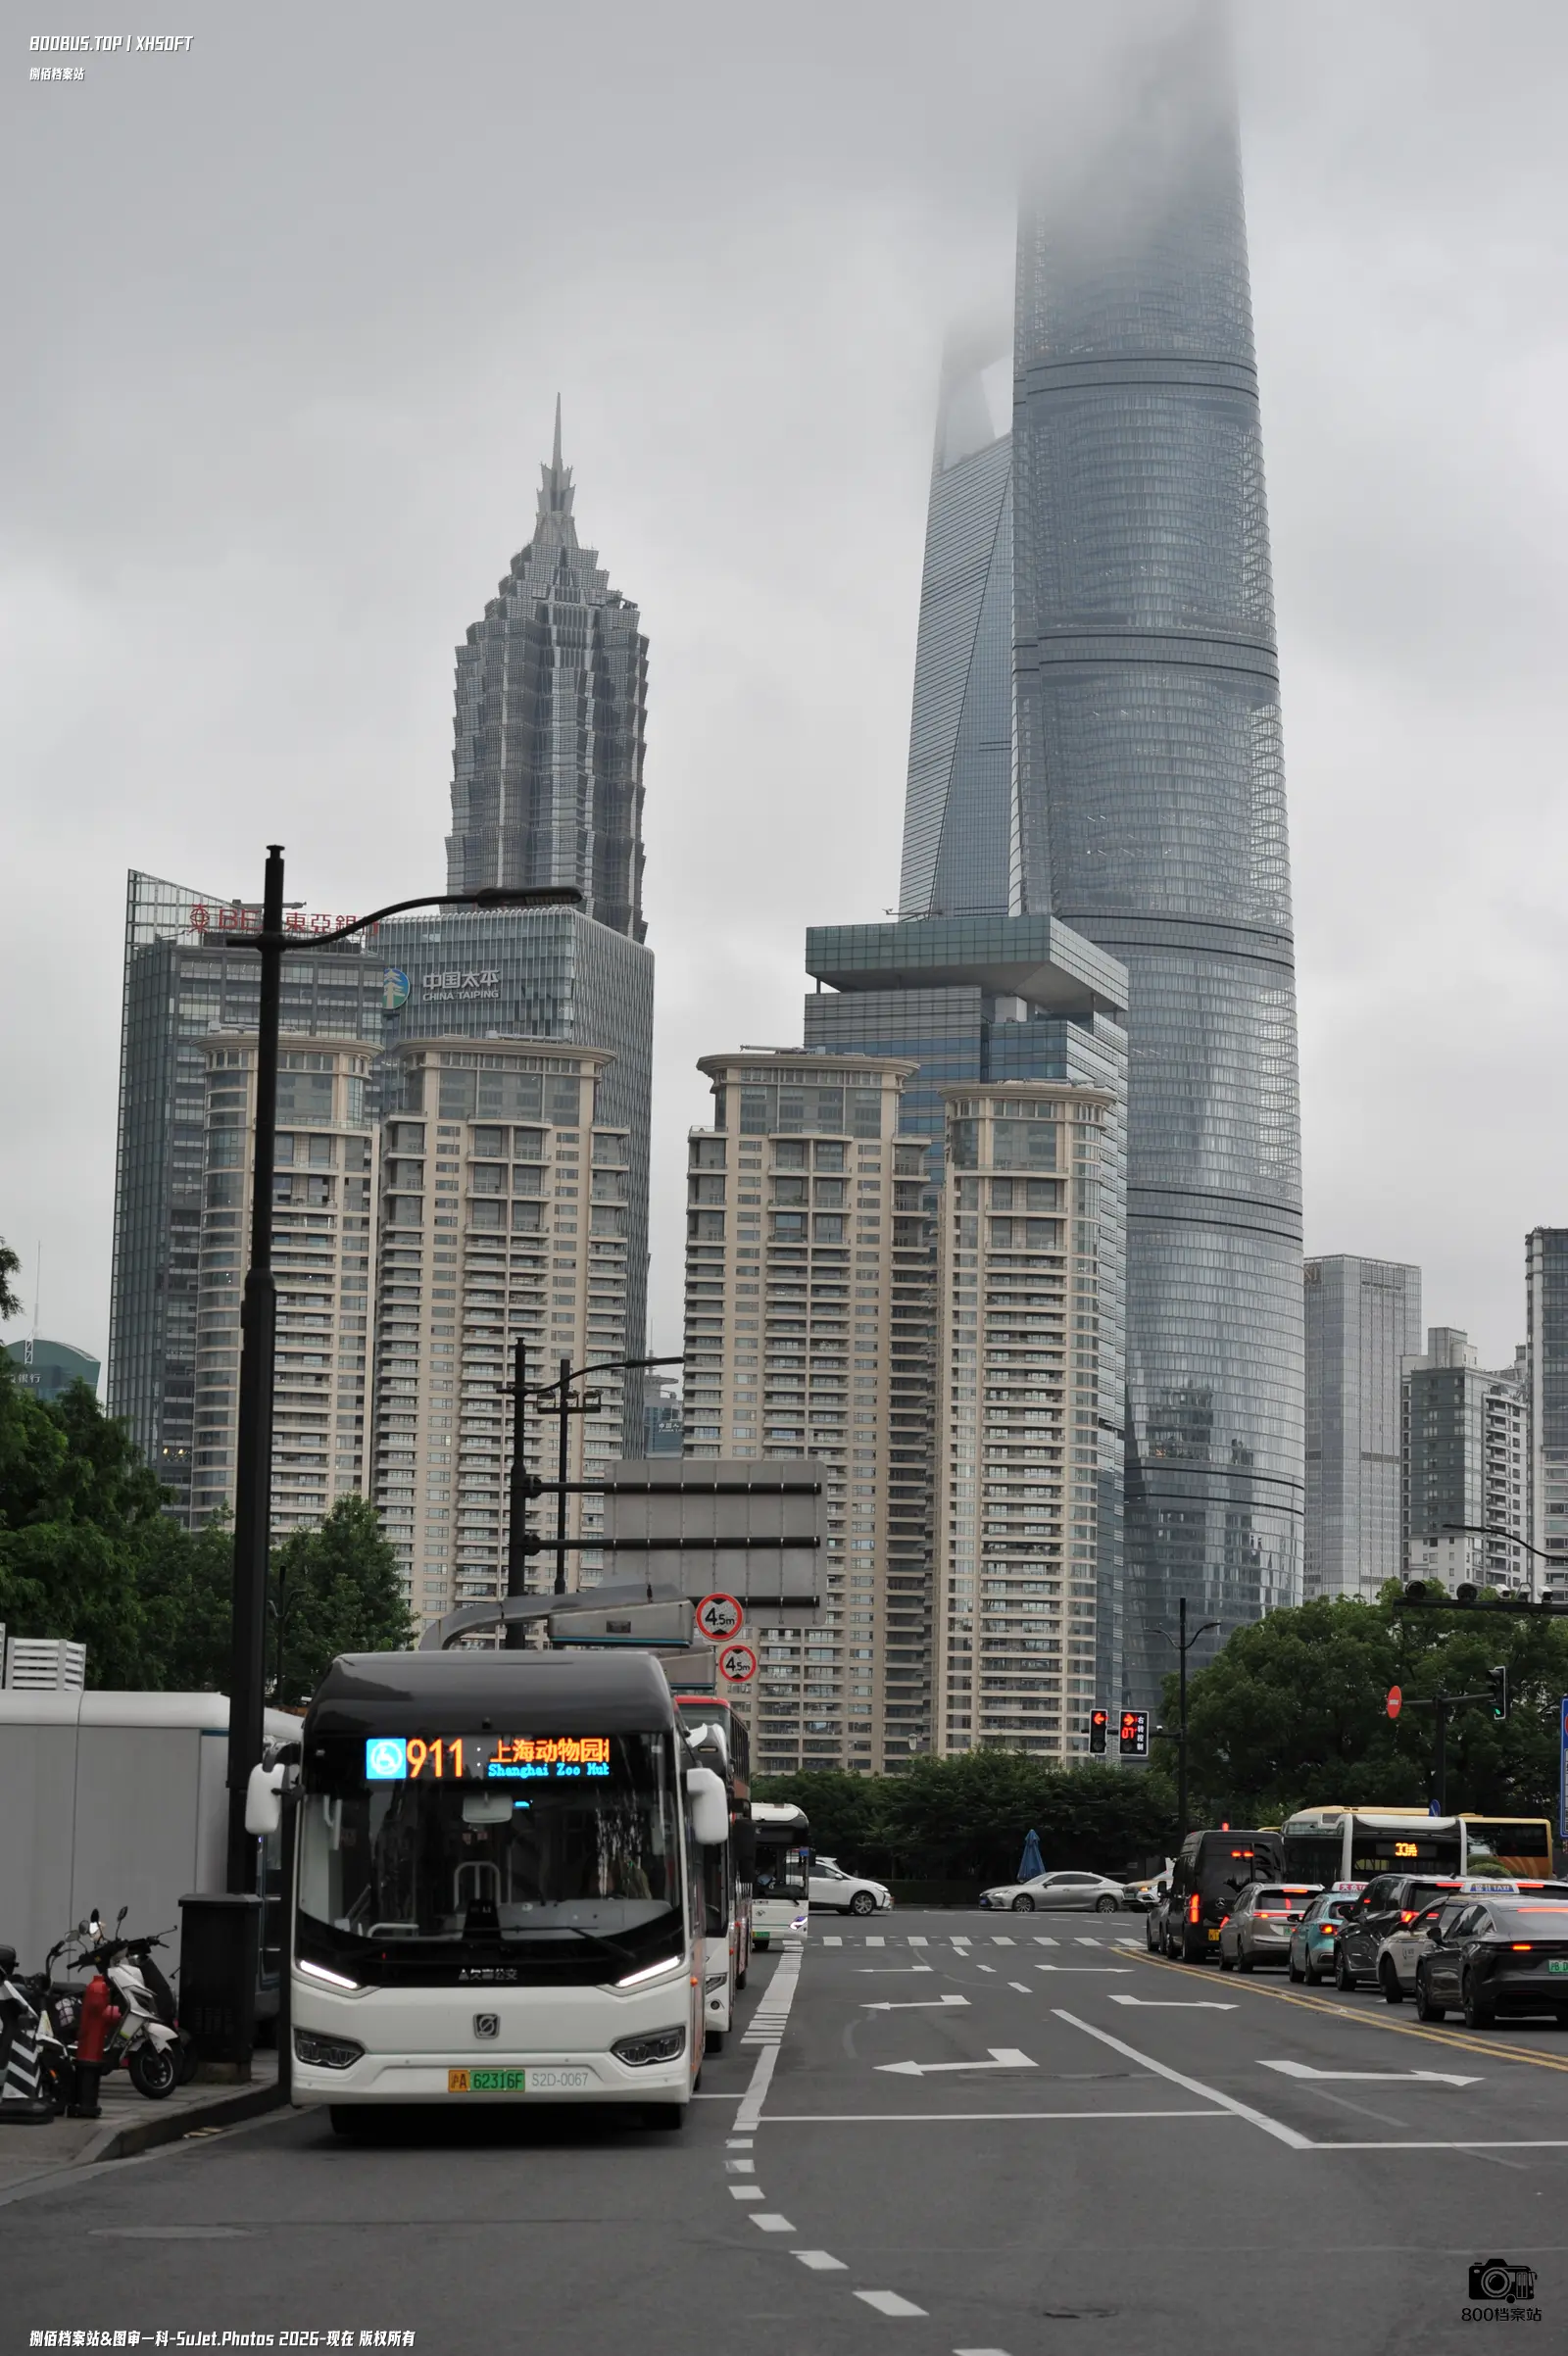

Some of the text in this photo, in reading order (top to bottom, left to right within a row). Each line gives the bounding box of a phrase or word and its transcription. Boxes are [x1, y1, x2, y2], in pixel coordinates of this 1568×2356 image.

[219, 909, 262, 930] BE
[423, 970, 500, 990] 中国太平
[422, 989, 499, 1002] CHINA TAIPING
[705, 1607, 735, 1626] 4.5m
[725, 1656, 751, 1672] 4.5m
[407, 1739, 463, 1778] 911
[488, 1763, 549, 1779] Shanghai
[557, 1763, 580, 1776] Zoo
[531, 2073, 588, 2086] S2D-0067
